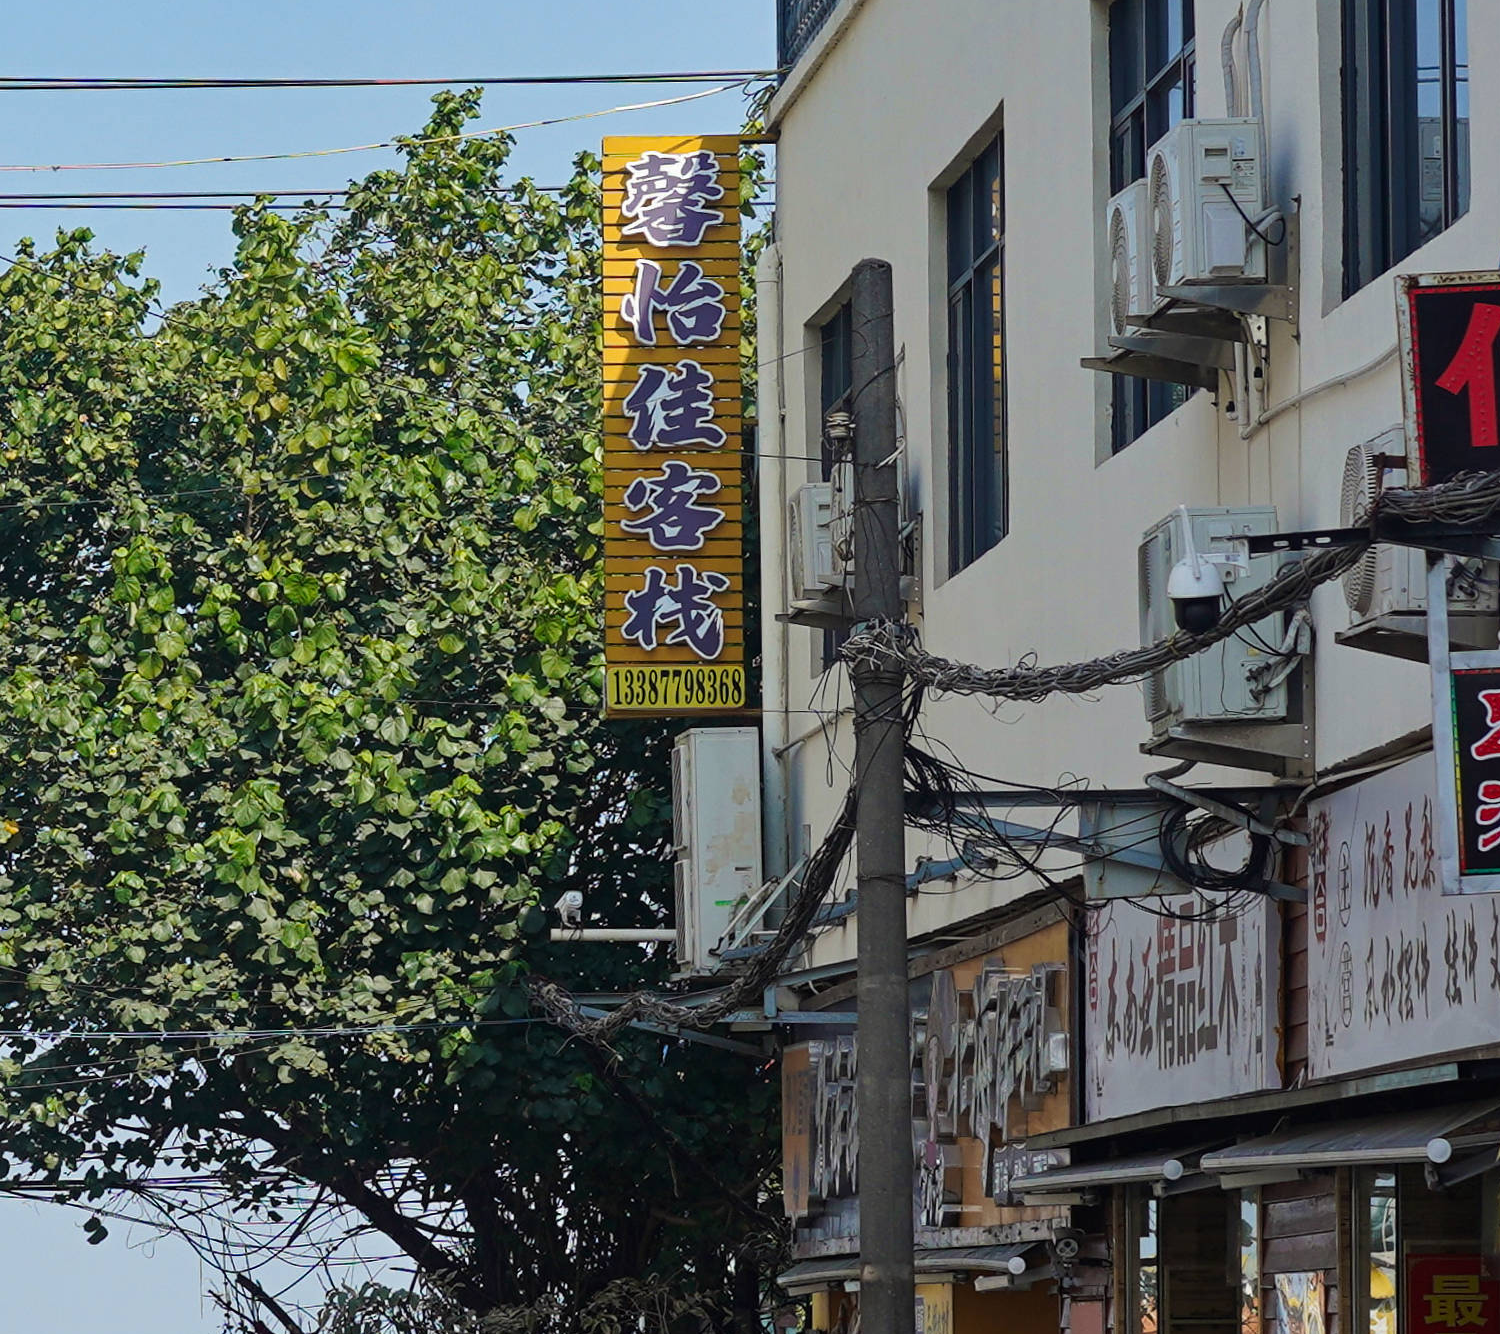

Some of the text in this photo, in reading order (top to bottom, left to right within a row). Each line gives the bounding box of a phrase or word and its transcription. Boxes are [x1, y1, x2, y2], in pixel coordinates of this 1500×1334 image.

[621, 149, 730, 661] 馨怡佳客栈
[612, 668, 744, 708] 13387798368
